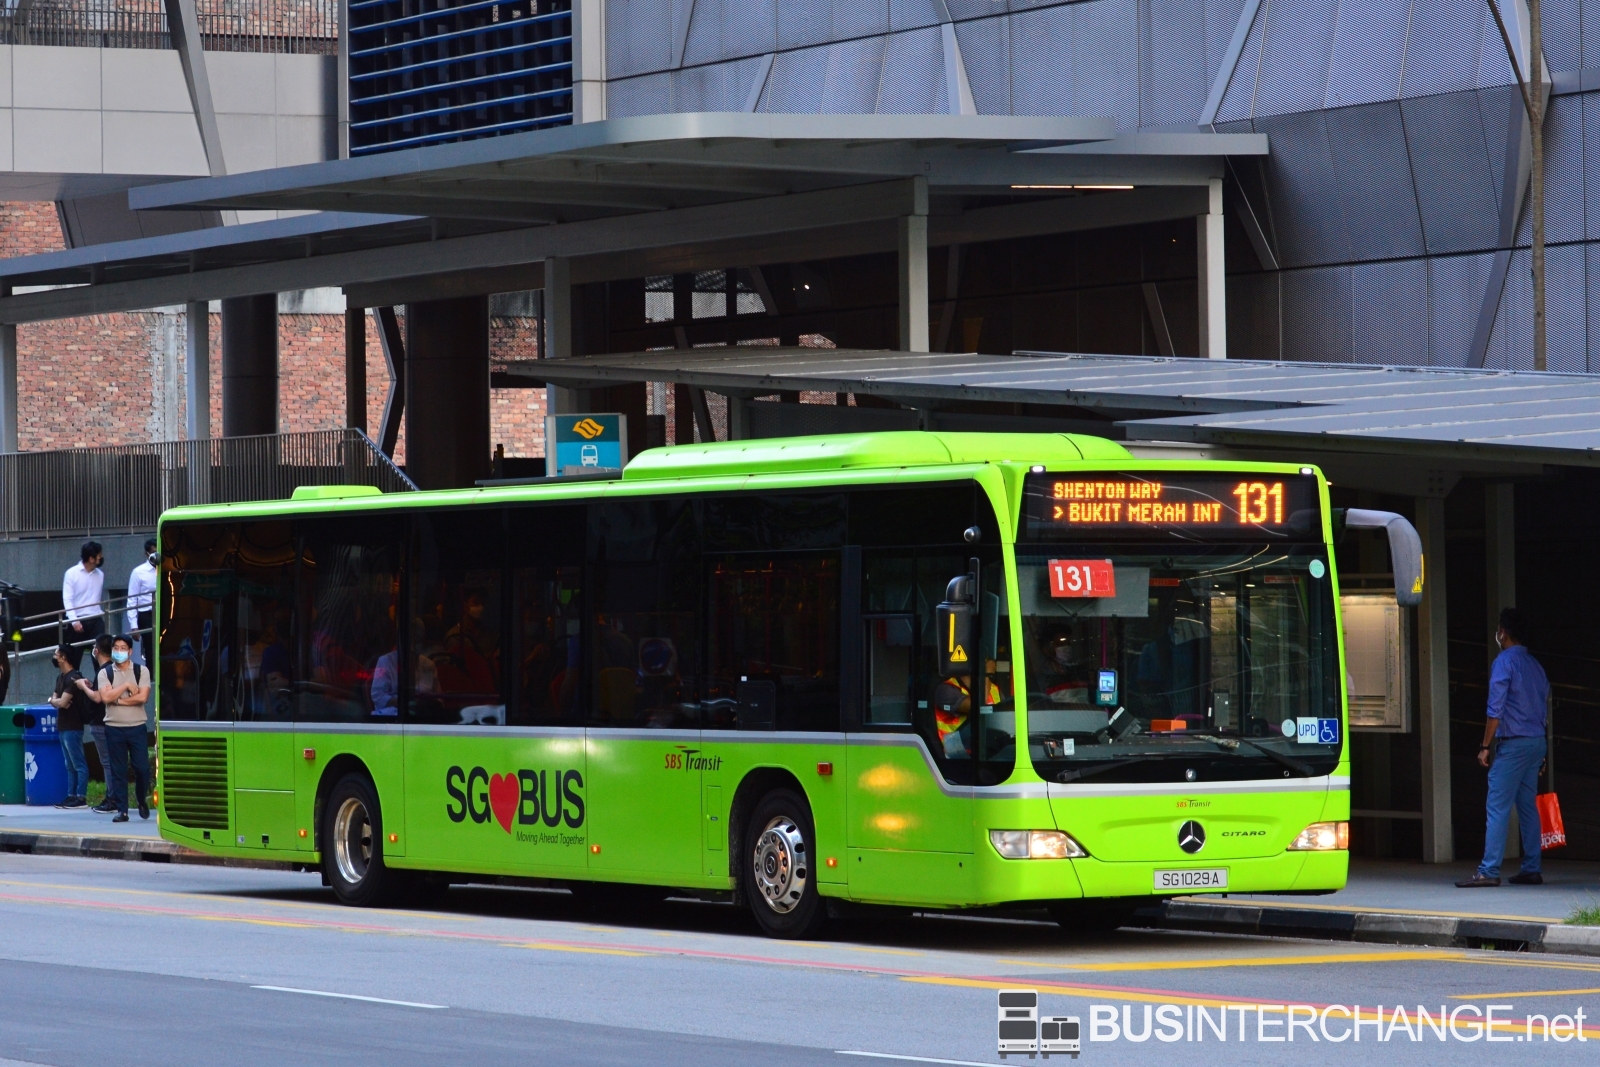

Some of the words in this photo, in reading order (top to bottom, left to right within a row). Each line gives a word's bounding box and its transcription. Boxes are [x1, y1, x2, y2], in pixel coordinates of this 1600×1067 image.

[1054, 482, 1126, 499] SHENTON
[1129, 482, 1161, 499] WAY
[1069, 503, 1122, 522] BUKIT
[1128, 503, 1186, 522] MERAH
[1193, 503, 1221, 522] INT
[1233, 482, 1282, 524] 131
[1055, 566, 1092, 591] 131
[1298, 724, 1317, 737] UPD
[664, 753, 682, 769] SBS
[681, 749, 724, 772] Transit
[446, 765, 491, 824] SG
[517, 769, 585, 828] BUS
[516, 831, 538, 845] Moving
[539, 832, 558, 844] Ahead
[560, 833, 585, 847] Together
[1162, 872, 1220, 886] SG1029A
